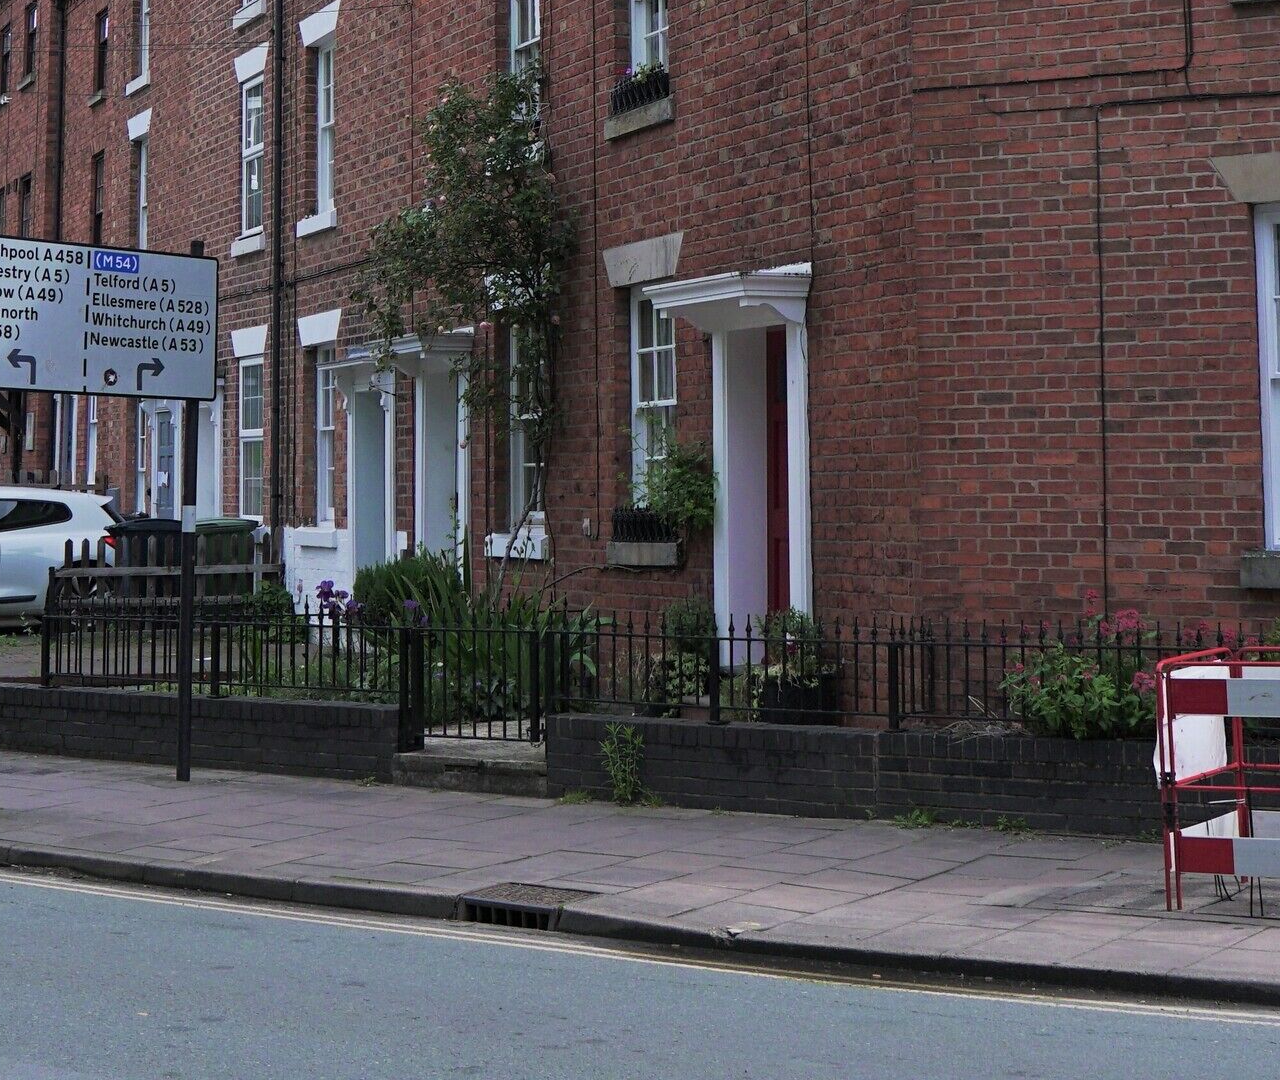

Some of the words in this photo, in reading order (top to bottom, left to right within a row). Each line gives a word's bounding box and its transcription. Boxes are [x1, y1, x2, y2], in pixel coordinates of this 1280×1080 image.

[94, 273, 140, 291] Telford
[92, 293, 156, 311] Ellesmere
[92, 312, 166, 331] Whitchurch
[90, 332, 159, 350] Newcastle
